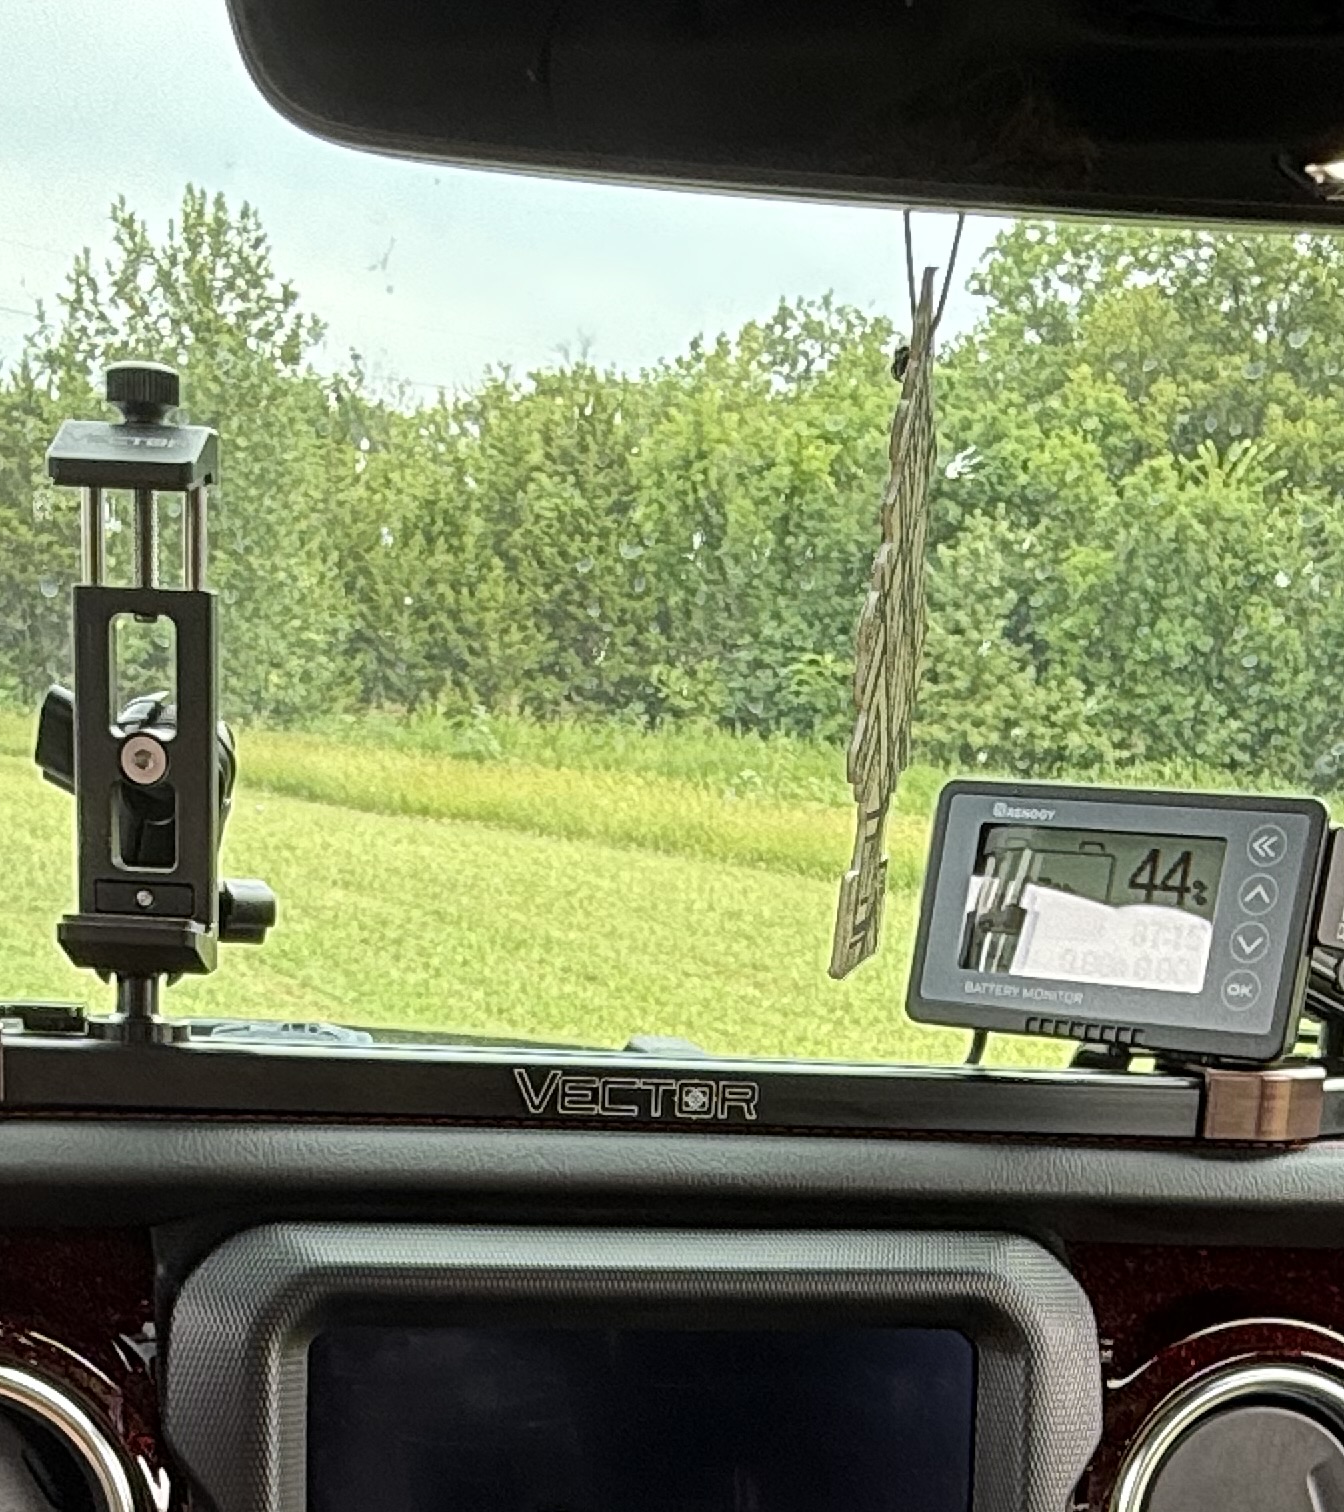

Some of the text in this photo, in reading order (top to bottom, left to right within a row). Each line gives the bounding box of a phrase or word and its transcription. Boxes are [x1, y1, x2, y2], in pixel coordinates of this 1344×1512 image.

[964, 981, 1084, 1005] BATTERY MONITOR
[1227, 983, 1253, 999] OK
[513, 1068, 760, 1120] VECTOR
